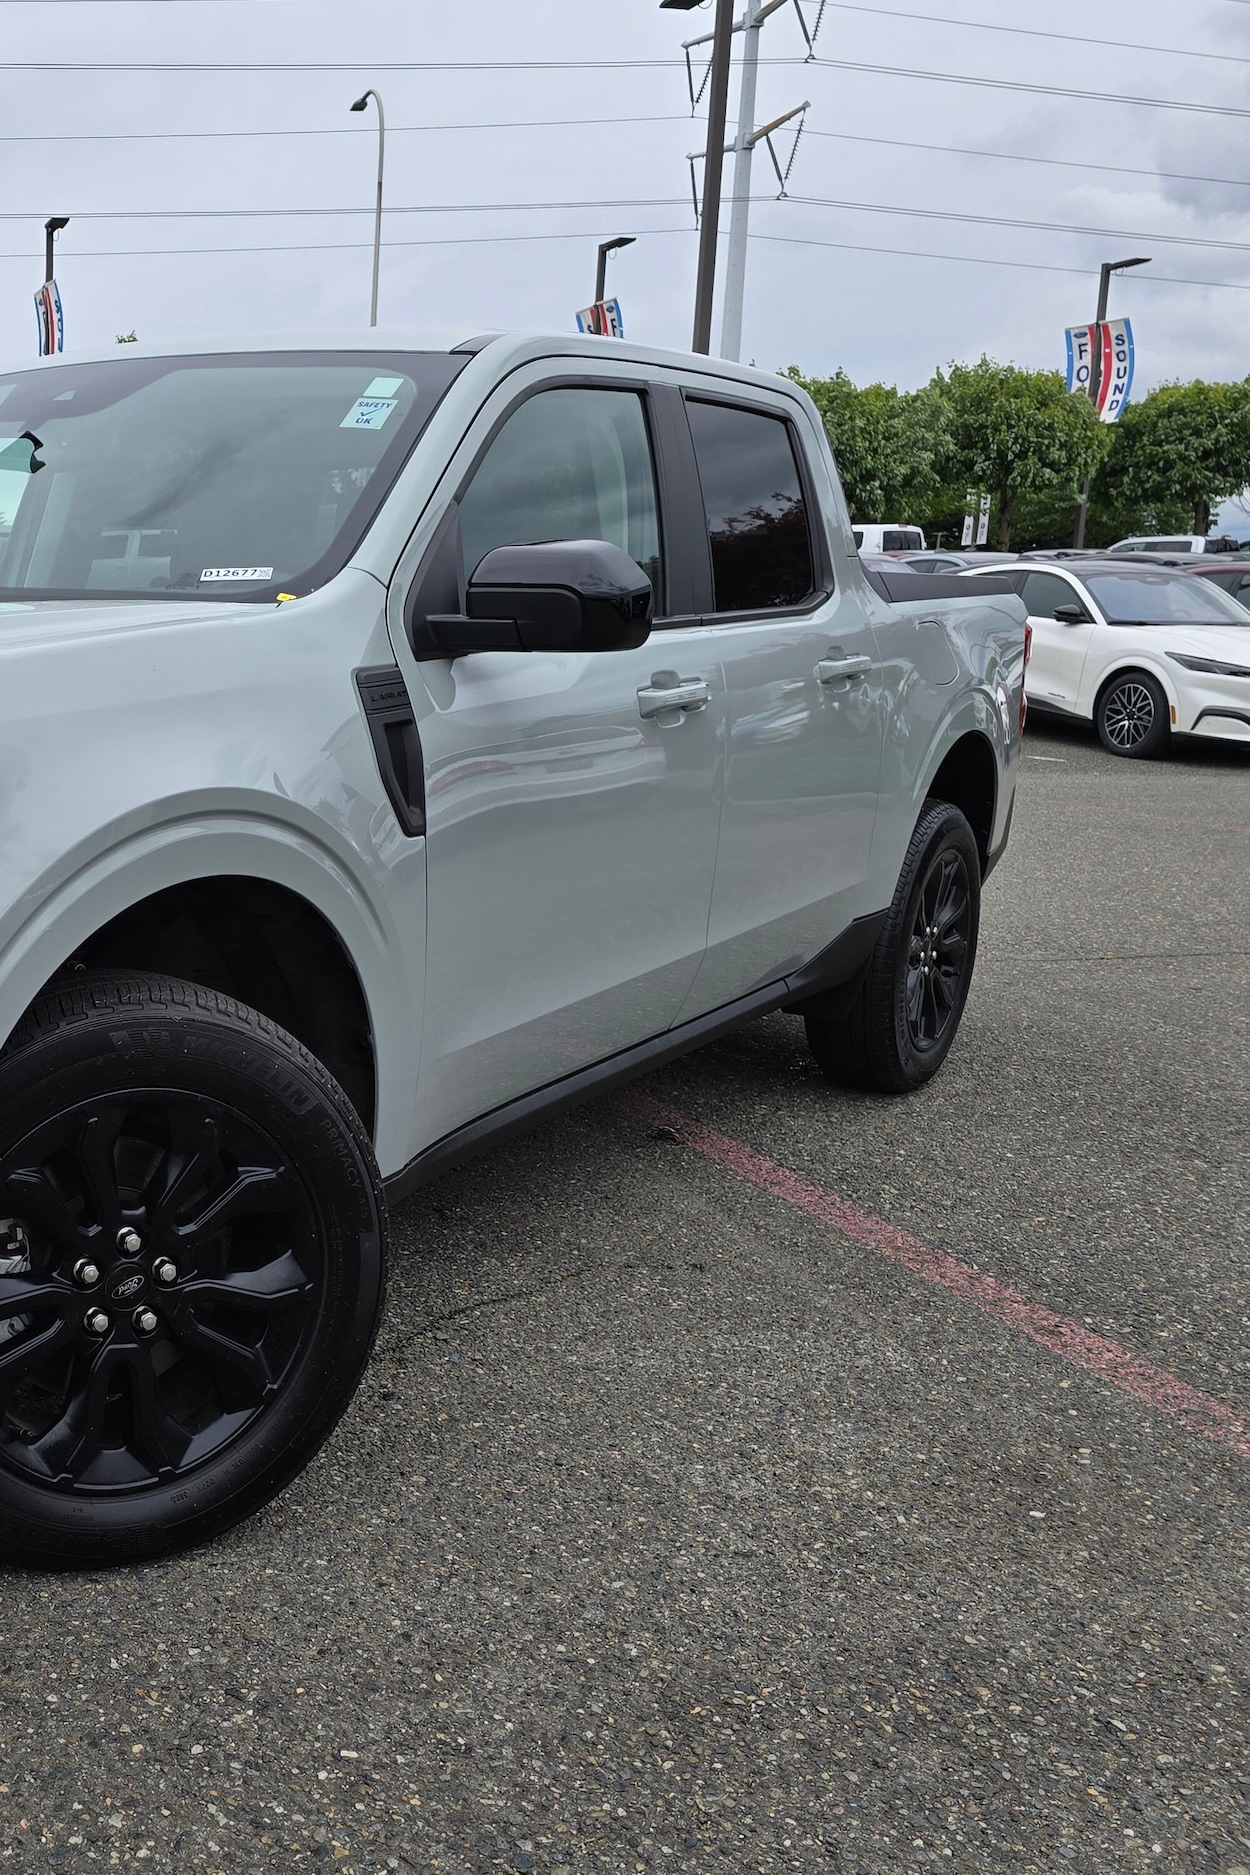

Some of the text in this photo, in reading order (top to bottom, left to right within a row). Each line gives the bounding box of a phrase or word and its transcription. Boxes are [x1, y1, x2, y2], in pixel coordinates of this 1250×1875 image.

[1108, 334, 1127, 411] SOUND
[357, 401, 393, 409] SAFETY
[355, 417, 373, 425] OK
[203, 568, 258, 578] D12677
[181, 1035, 311, 1108] MICHELIN
[319, 1118, 362, 1189] PRIMACY
[118, 1278, 139, 1296] Ford
